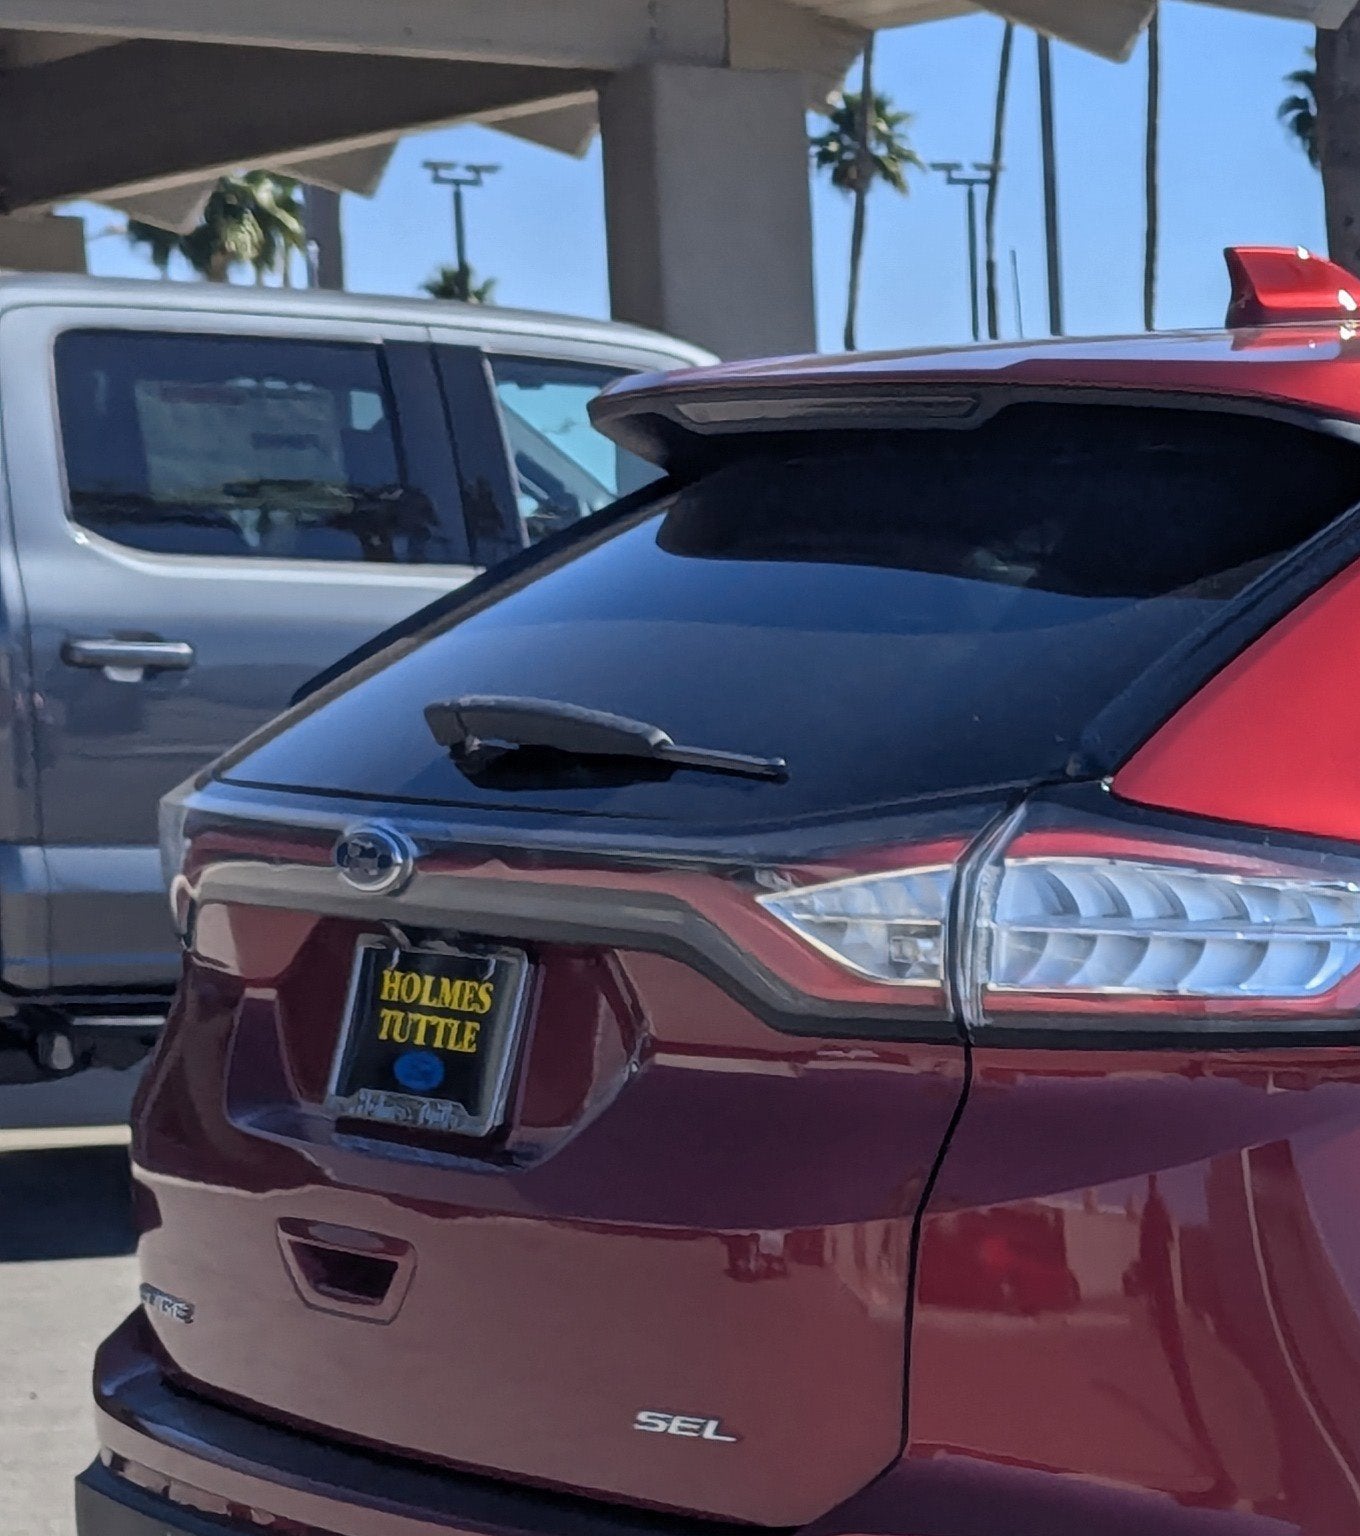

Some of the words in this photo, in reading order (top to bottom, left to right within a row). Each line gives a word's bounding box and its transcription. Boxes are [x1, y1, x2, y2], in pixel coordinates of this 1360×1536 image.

[379, 968, 495, 1015] HOLMES
[378, 1008, 481, 1053] TUTTLE
[633, 1410, 738, 1442] SEL
